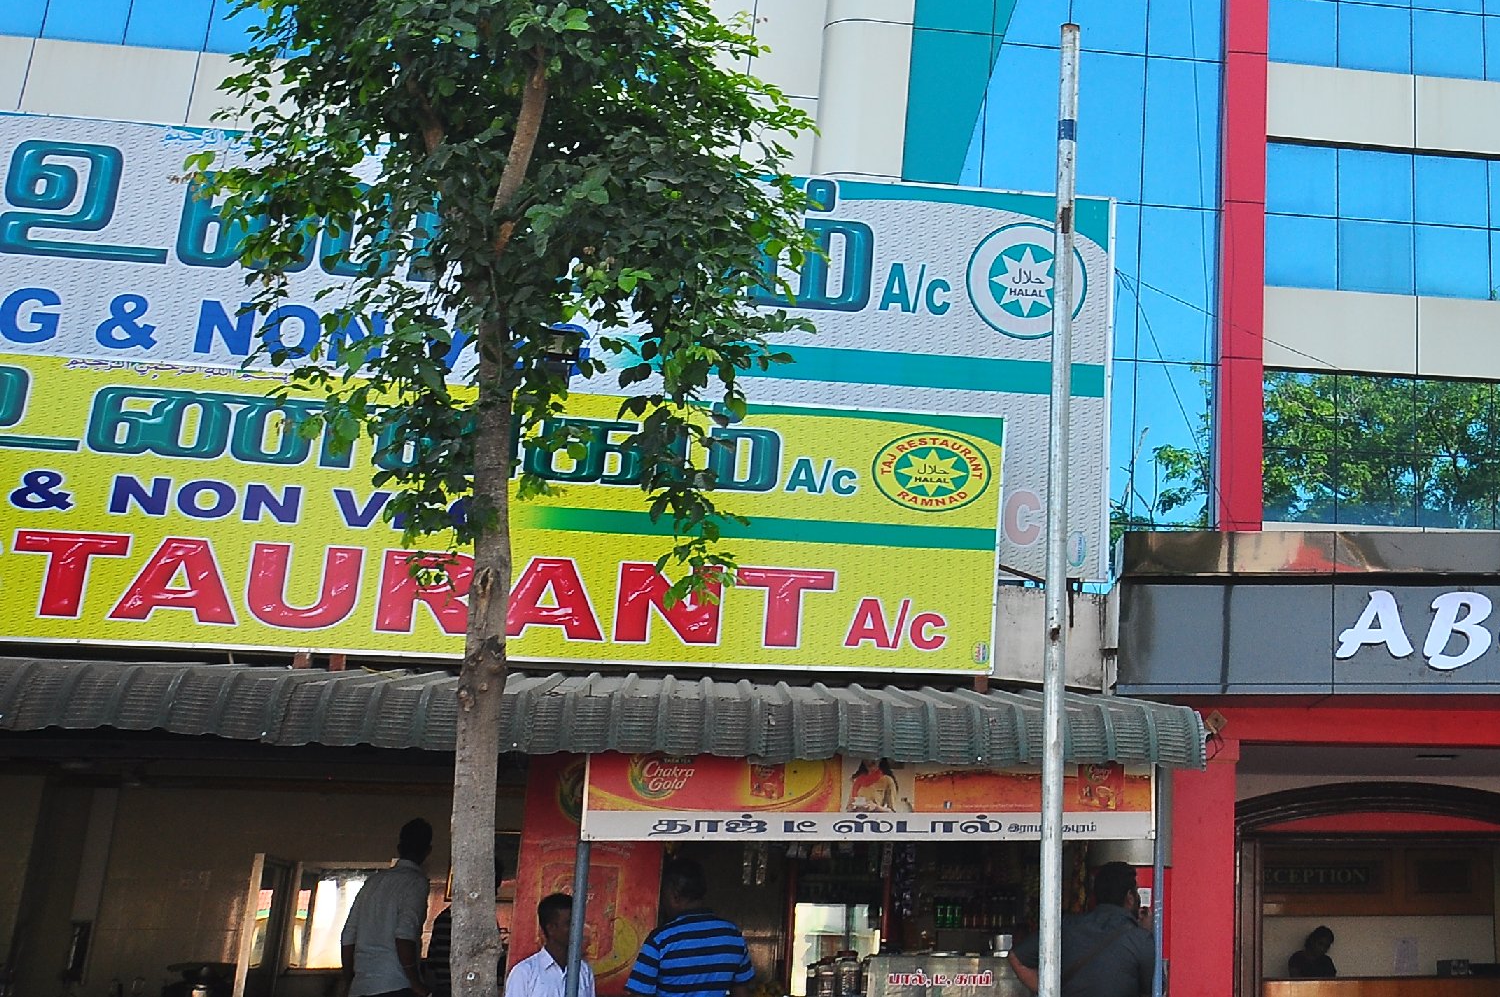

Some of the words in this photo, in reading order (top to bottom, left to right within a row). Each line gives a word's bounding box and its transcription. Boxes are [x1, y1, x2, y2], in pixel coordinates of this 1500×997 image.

[1009, 288, 1045, 298] HALAL
[96, 293, 158, 350] &
[881, 453, 897, 475] TAJ
[896, 437, 983, 480] RESTAURANT
[10, 470, 74, 510] &
[109, 475, 298, 523] NON
[897, 490, 968, 507] RAMNAD
[643, 761, 696, 778] Chakra
[648, 777, 687, 791] Gold
[648, 813, 768, 837] தாஜ்
[783, 819, 819, 834] டீ
[832, 813, 1002, 834] ஸ்டால்
